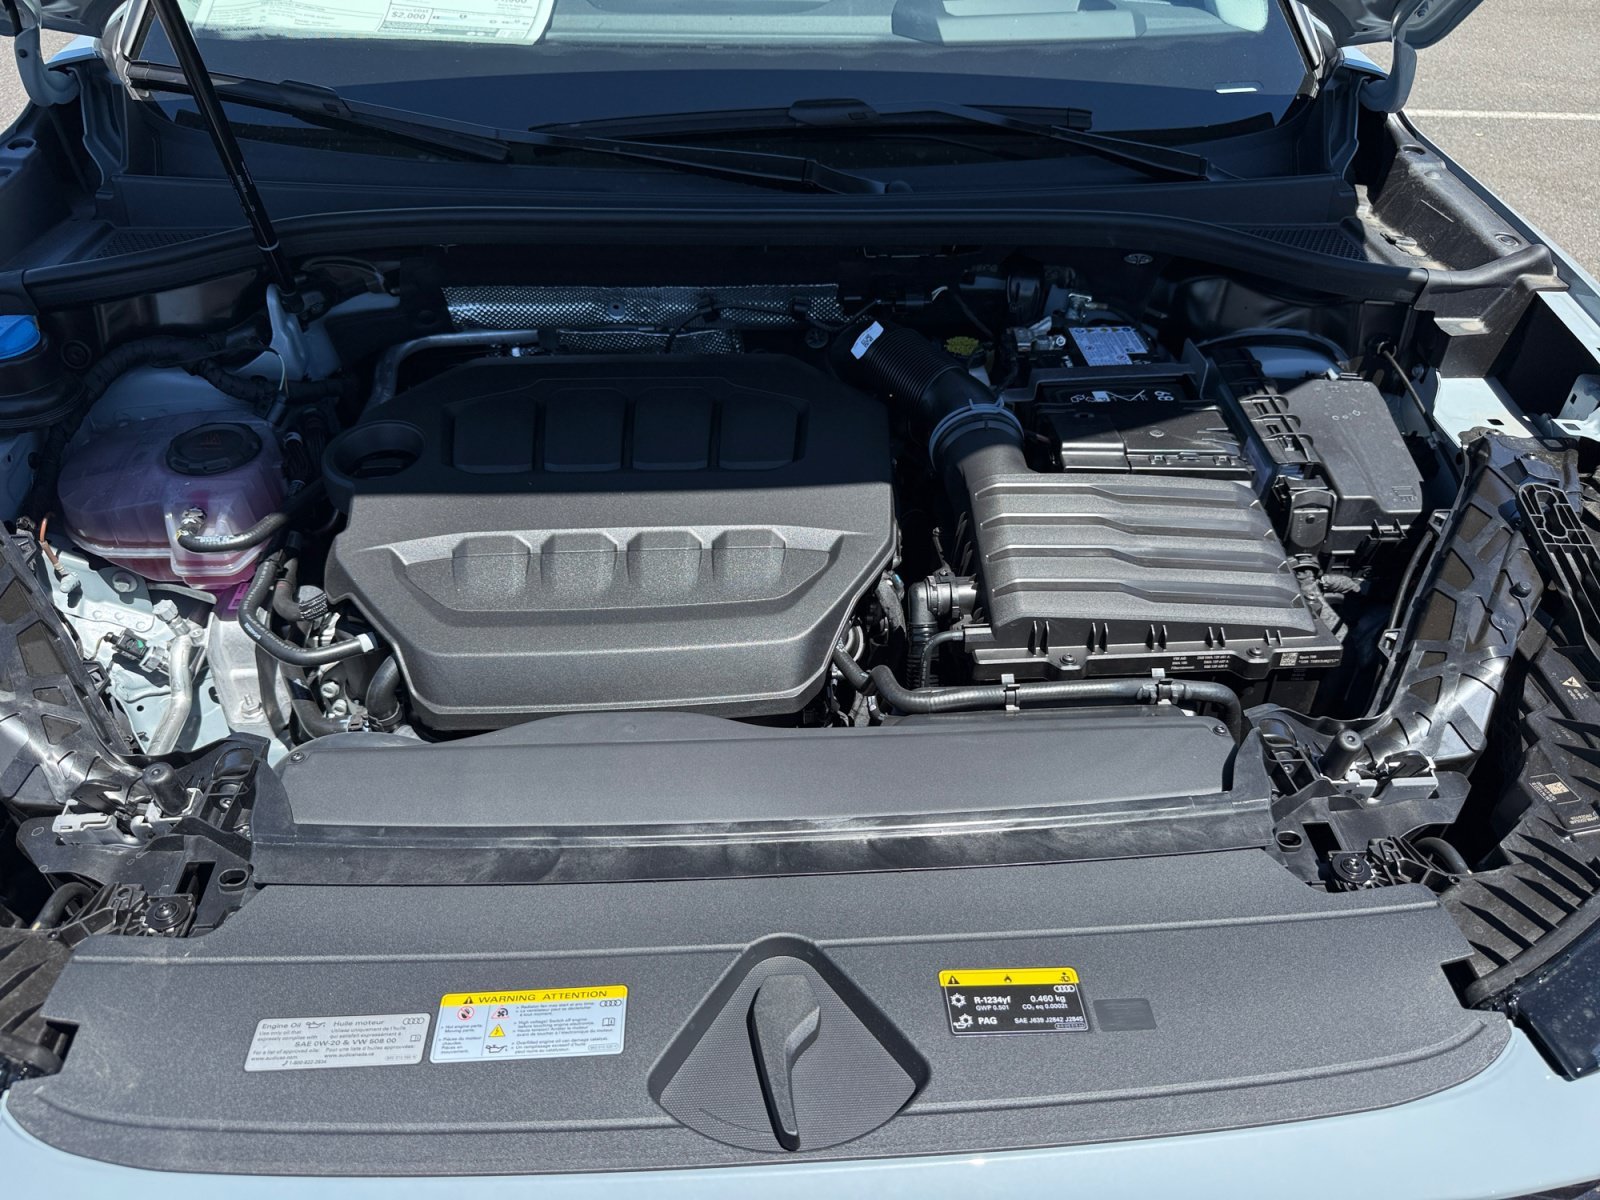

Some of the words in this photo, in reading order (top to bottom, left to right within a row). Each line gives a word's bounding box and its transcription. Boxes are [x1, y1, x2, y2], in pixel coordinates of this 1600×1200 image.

[392, 11, 426, 20] $2,000
[479, 994, 536, 1003] WARNING
[543, 991, 608, 1000] ATTENTION
[974, 996, 1011, 1004] R-1234yf
[1055, 995, 1066, 1003] kg
[978, 1017, 997, 1025] PAG
